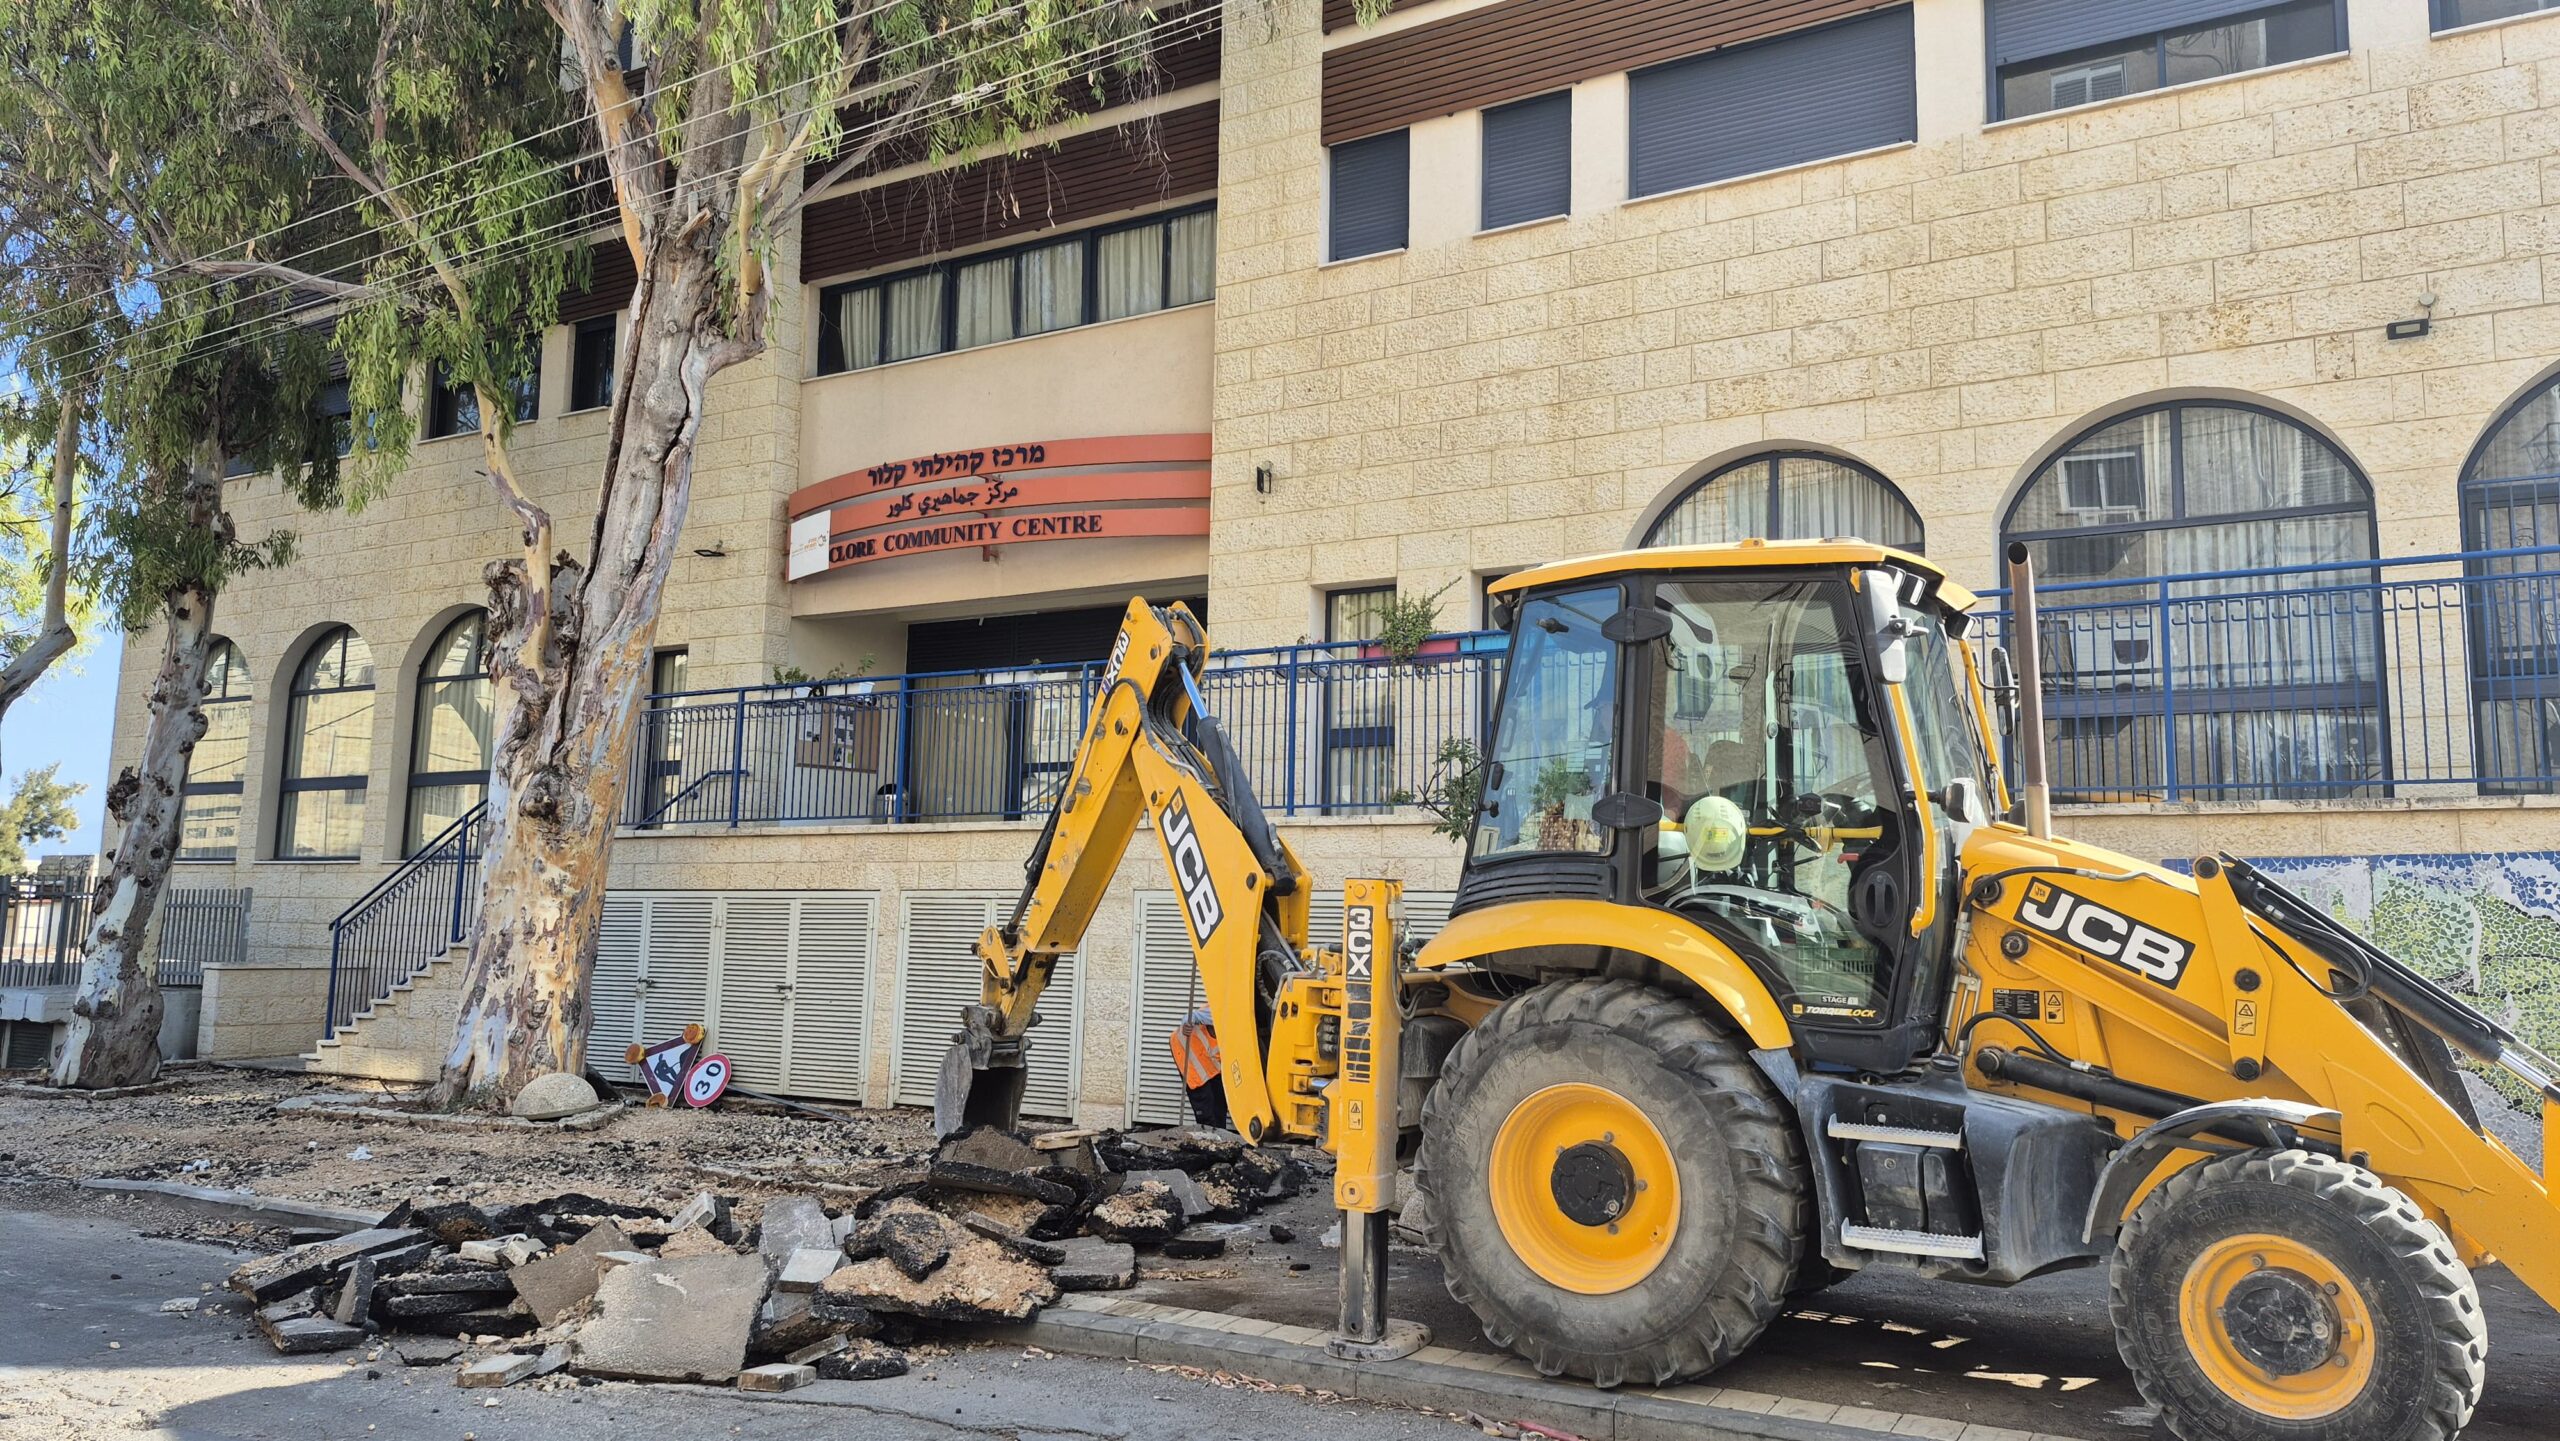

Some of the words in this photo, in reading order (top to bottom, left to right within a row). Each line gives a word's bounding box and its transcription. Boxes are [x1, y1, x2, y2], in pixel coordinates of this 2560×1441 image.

[912, 451, 984, 477] קהילתי
[992, 444, 1045, 466] מרכז
[868, 462, 907, 487] קלור
[887, 493, 914, 518] كلور
[918, 487, 979, 515] جماهيري
[985, 479, 1018, 504] مركز
[829, 538, 876, 563] CLORE
[883, 521, 1002, 552] COMMUNITY
[1012, 515, 1102, 537] CENTRE
[1105, 631, 1130, 686] 3CX
[1162, 807, 1220, 940] JCB
[1347, 907, 1373, 976] 3CX
[2021, 893, 2186, 981] JCB
[695, 1062, 722, 1095] 30
